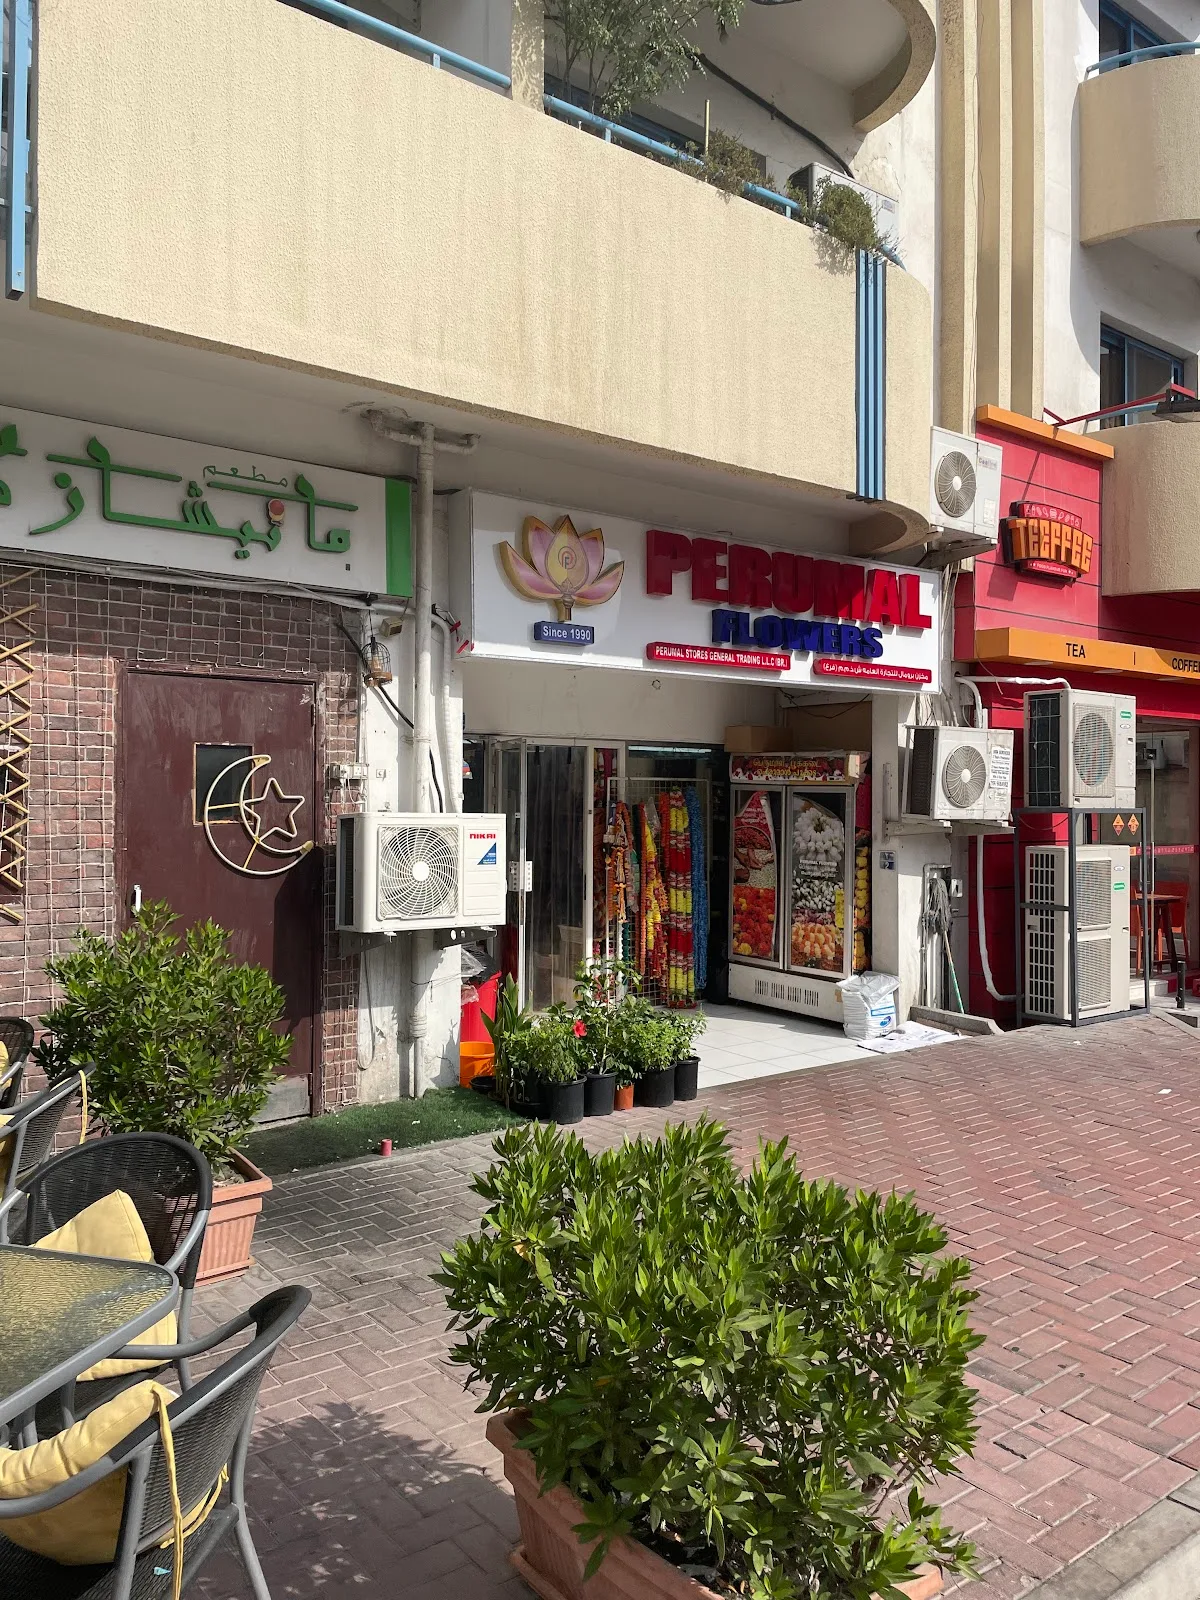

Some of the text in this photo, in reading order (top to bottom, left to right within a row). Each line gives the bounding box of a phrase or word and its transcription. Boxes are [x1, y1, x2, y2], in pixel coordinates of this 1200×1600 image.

[203, 465, 288, 488] مطعم
[1009, 518, 1093, 574] TEEFFEE
[647, 530, 931, 628] PERUMAL
[543, 625, 591, 641] Since 1990
[712, 609, 883, 659] FLOWERS
[655, 645, 685, 658] PERUMAL
[685, 649, 709, 660] STORES
[709, 651, 736, 663] GENERAL
[736, 653, 761, 665] TRADING
[1065, 642, 1200, 673] TEA COFFE
